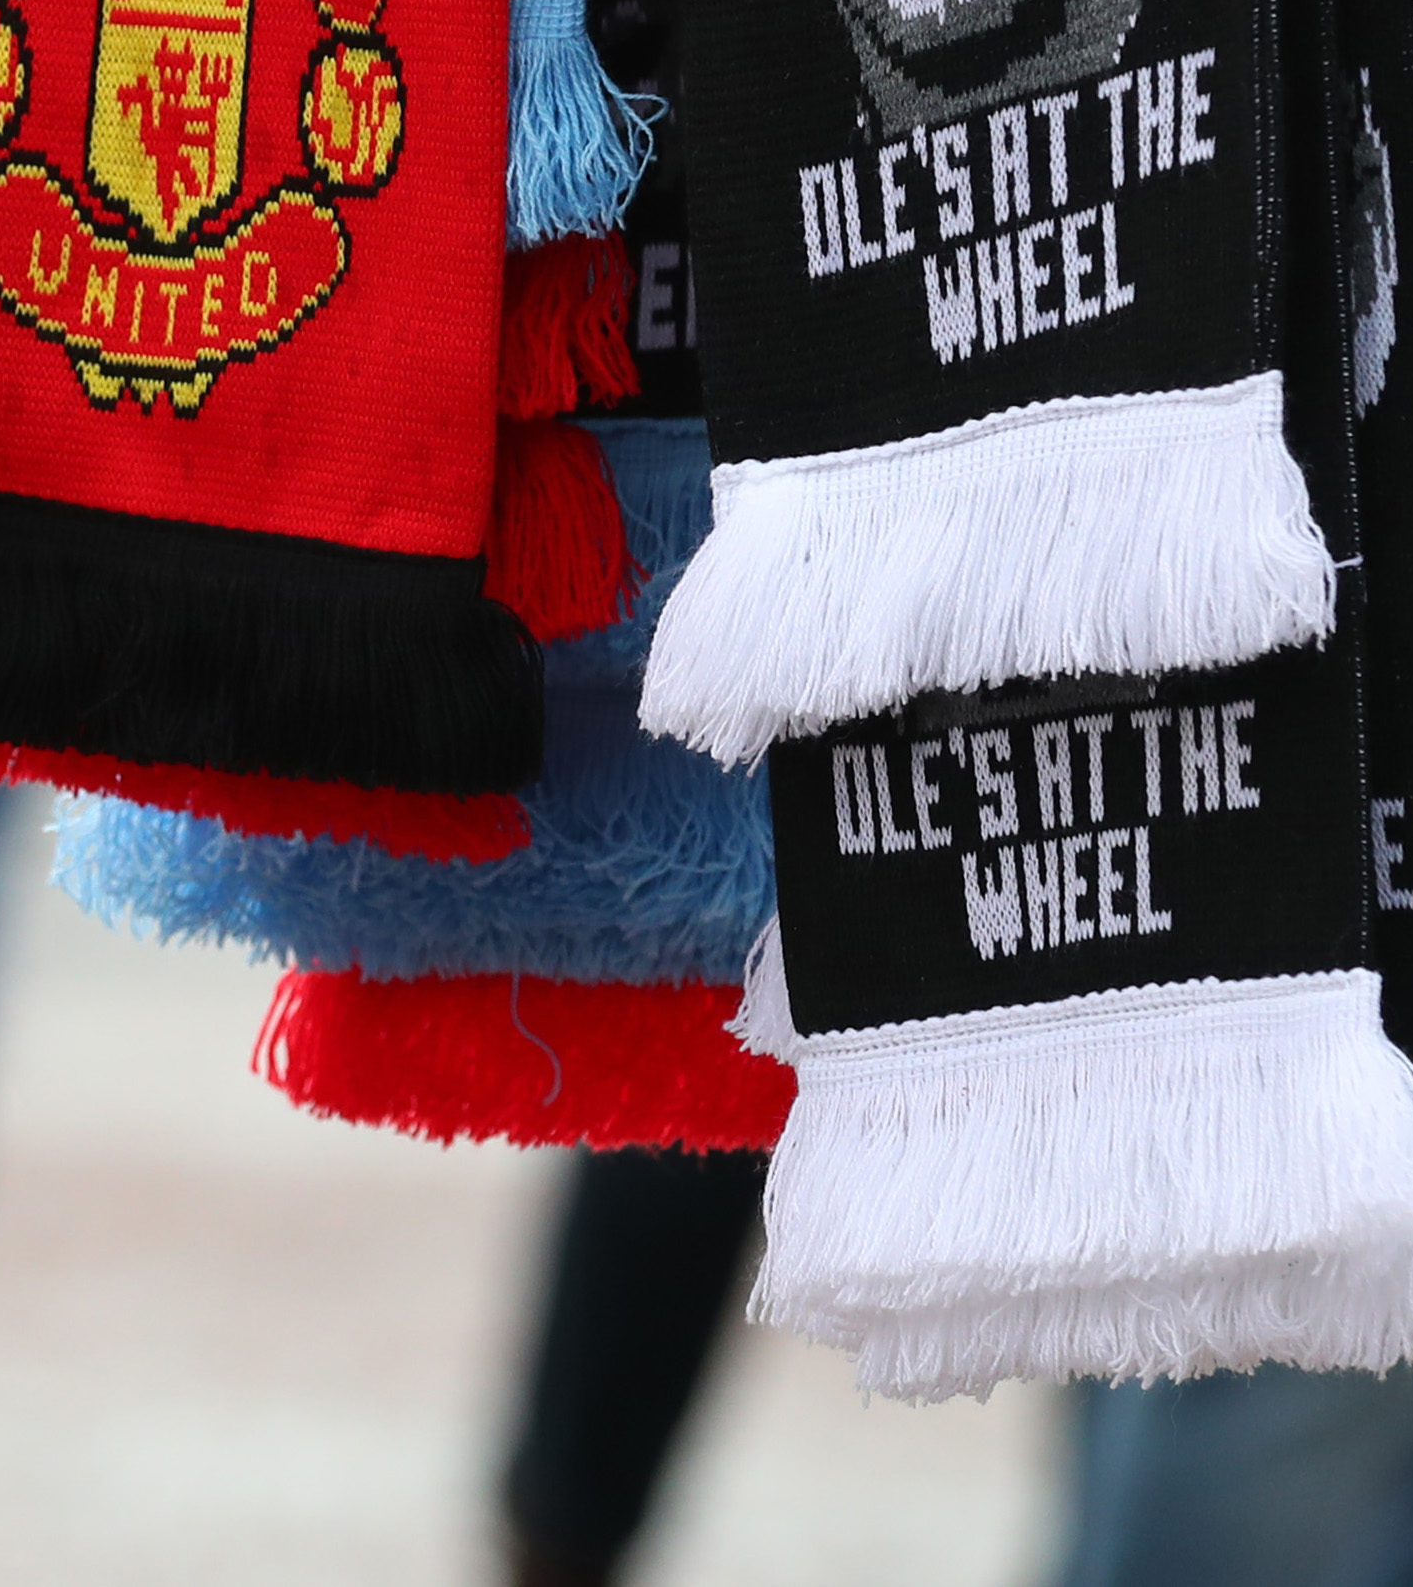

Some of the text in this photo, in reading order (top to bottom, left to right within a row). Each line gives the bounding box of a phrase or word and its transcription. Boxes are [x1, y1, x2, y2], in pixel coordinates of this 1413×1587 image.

[798, 48, 1216, 279] OLE'S AT THE
[31, 229, 278, 345] UNITED
[923, 202, 1136, 365] WHEEL
[831, 700, 1262, 856] OLE'S AT THE
[961, 826, 1173, 960] WHEEL
